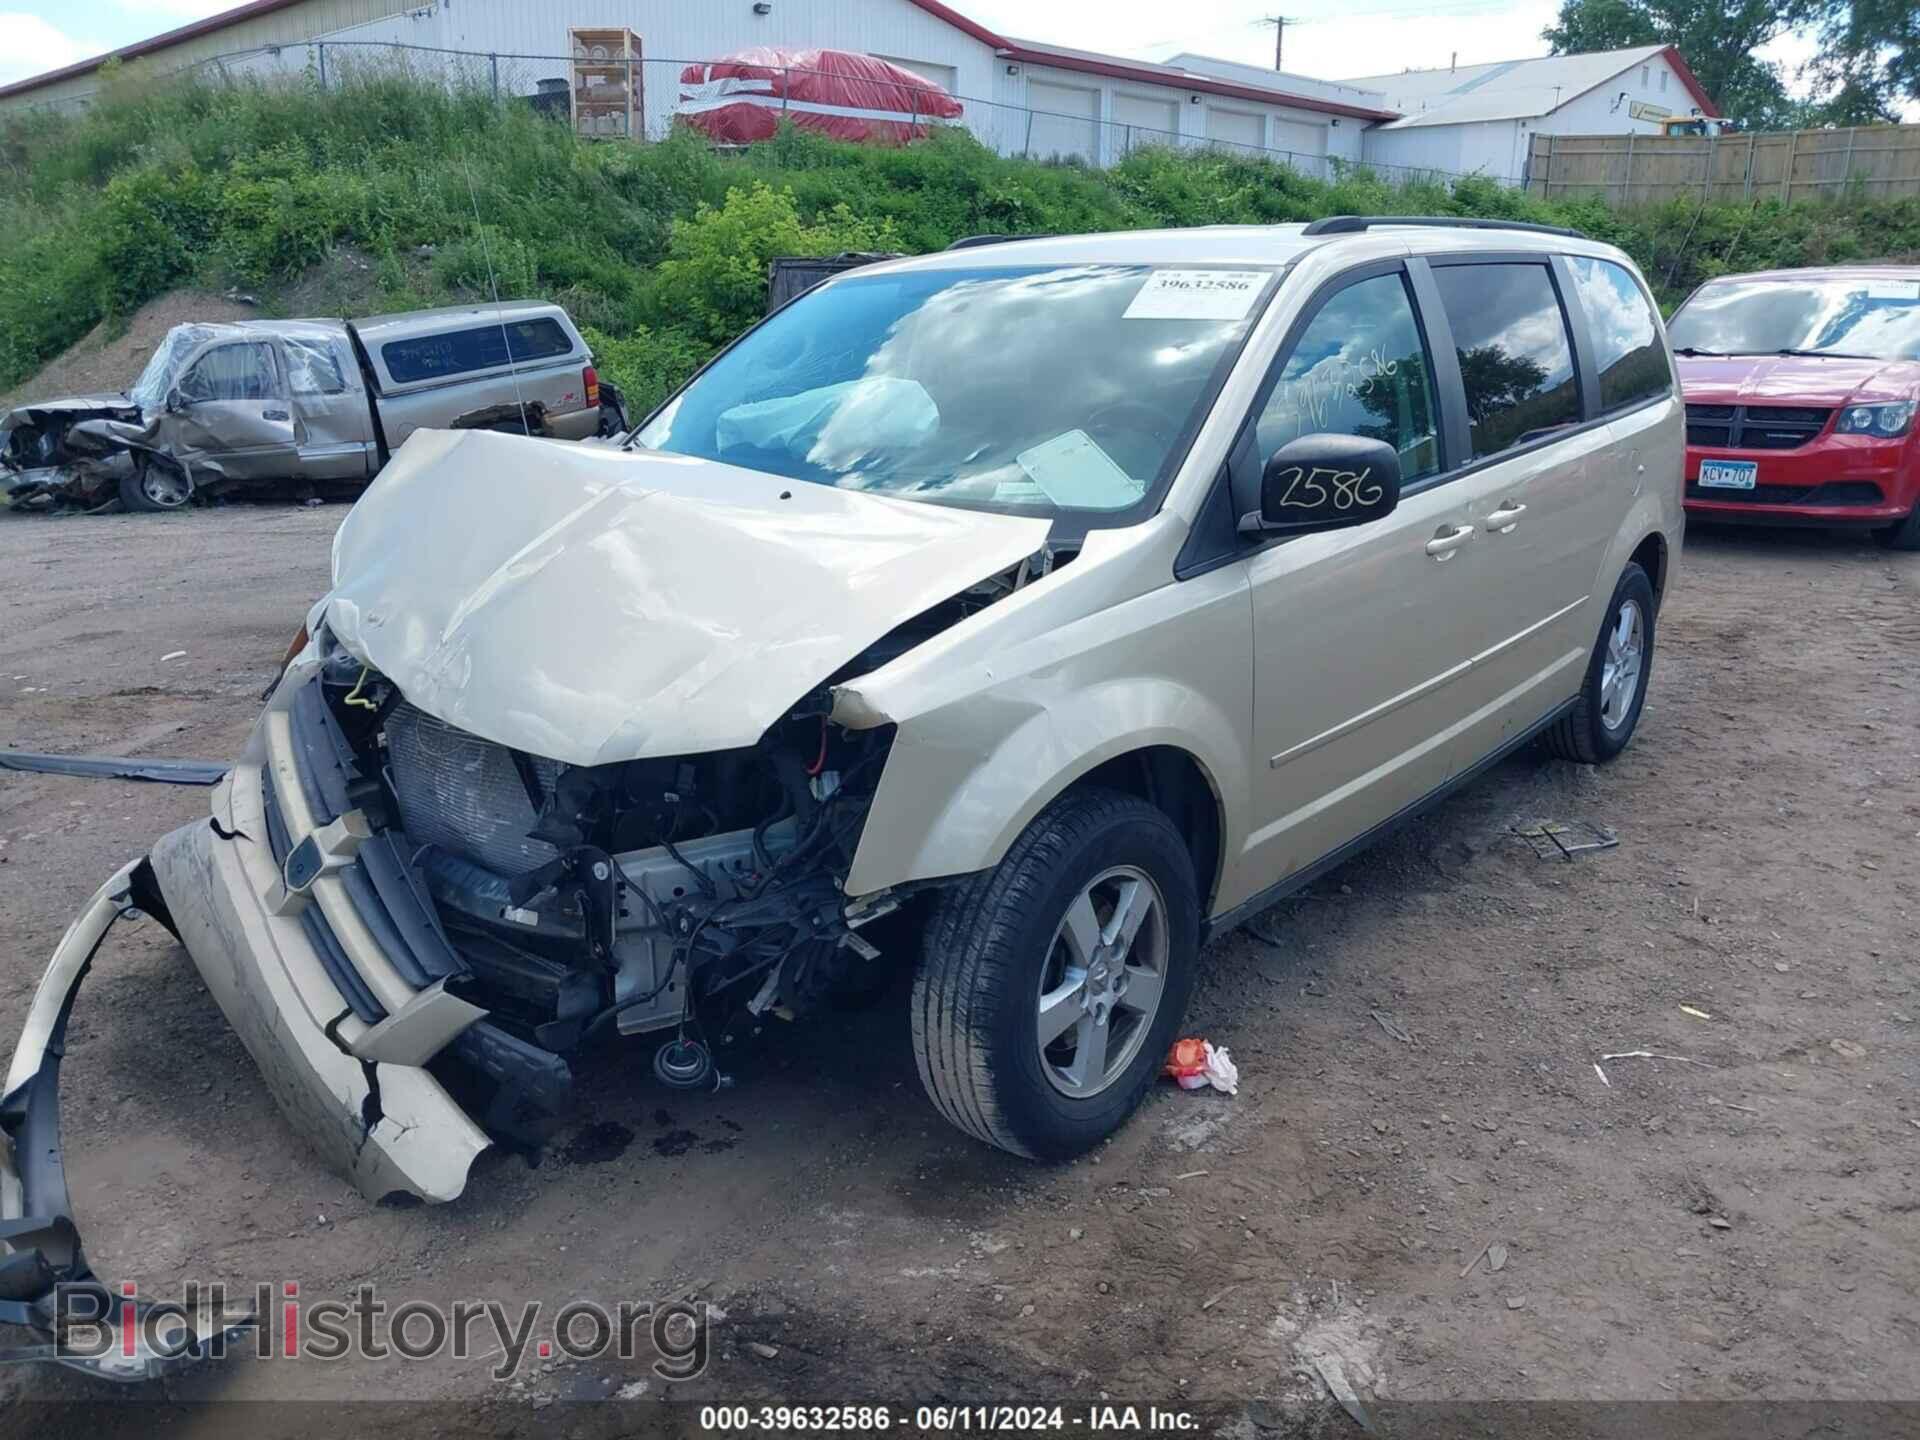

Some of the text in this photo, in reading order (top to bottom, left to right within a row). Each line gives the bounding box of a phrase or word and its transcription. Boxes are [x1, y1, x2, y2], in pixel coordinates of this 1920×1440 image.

[1159, 279, 1251, 290] 39632586
[1702, 467, 1753, 482] KCV 707
[1278, 466, 1383, 509] 2586
